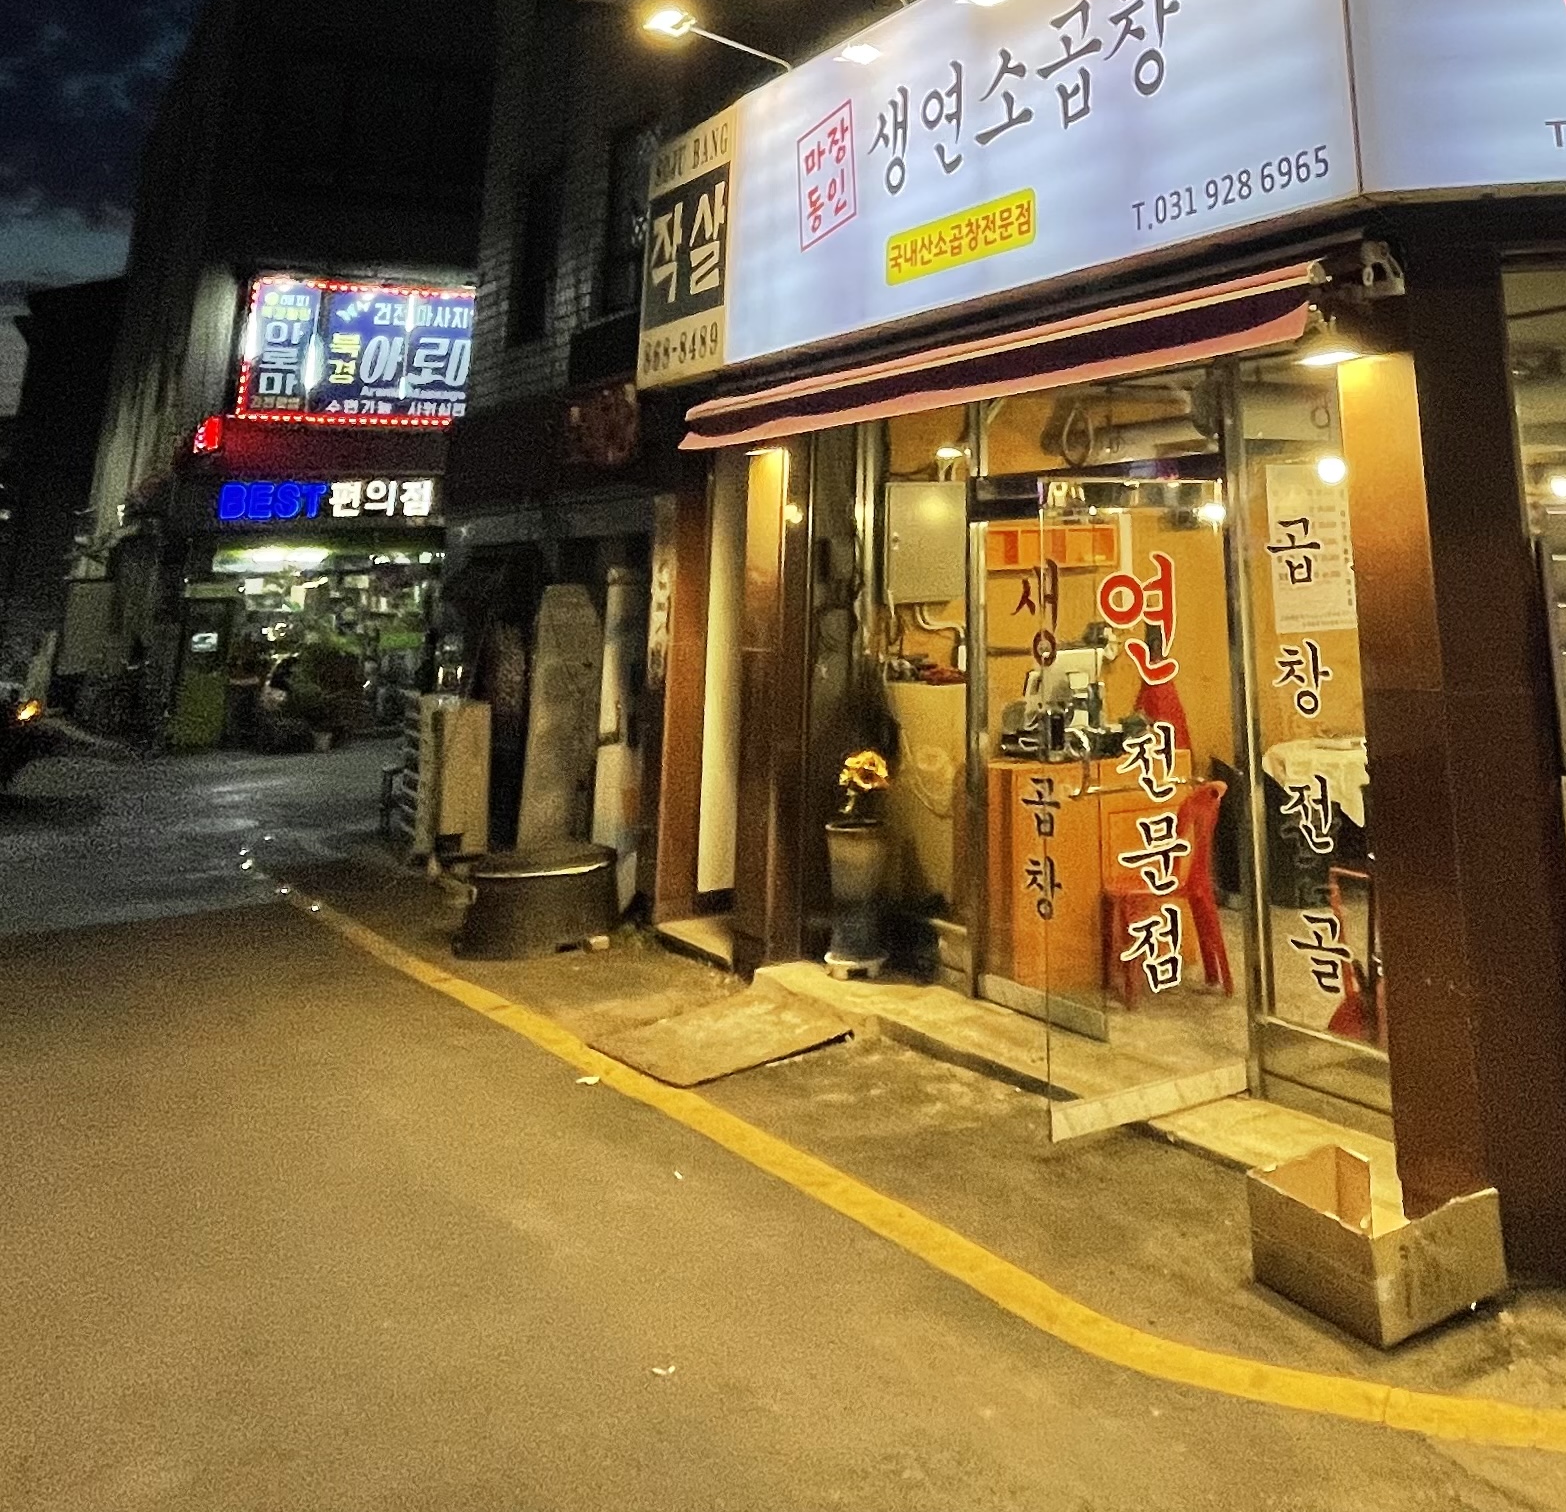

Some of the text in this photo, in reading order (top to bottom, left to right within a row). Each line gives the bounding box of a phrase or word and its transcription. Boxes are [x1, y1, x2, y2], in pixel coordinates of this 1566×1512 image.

[692, 122, 729, 171] BANG
[1131, 144, 1331, 232] T.031 928 6965
[650, 179, 727, 305] 작살
[888, 199, 1033, 271] 국내산소곱창전문점
[415, 304, 470, 329] 마사지
[258, 321, 304, 396] 아로마
[218, 480, 330, 522] BEST
[329, 479, 436, 519] 편의점
[1098, 549, 1180, 687] 연
[1266, 516, 1356, 995] 곱창전골
[1020, 776, 1063, 923] 곱창
[1117, 722, 1193, 995] 전문점
